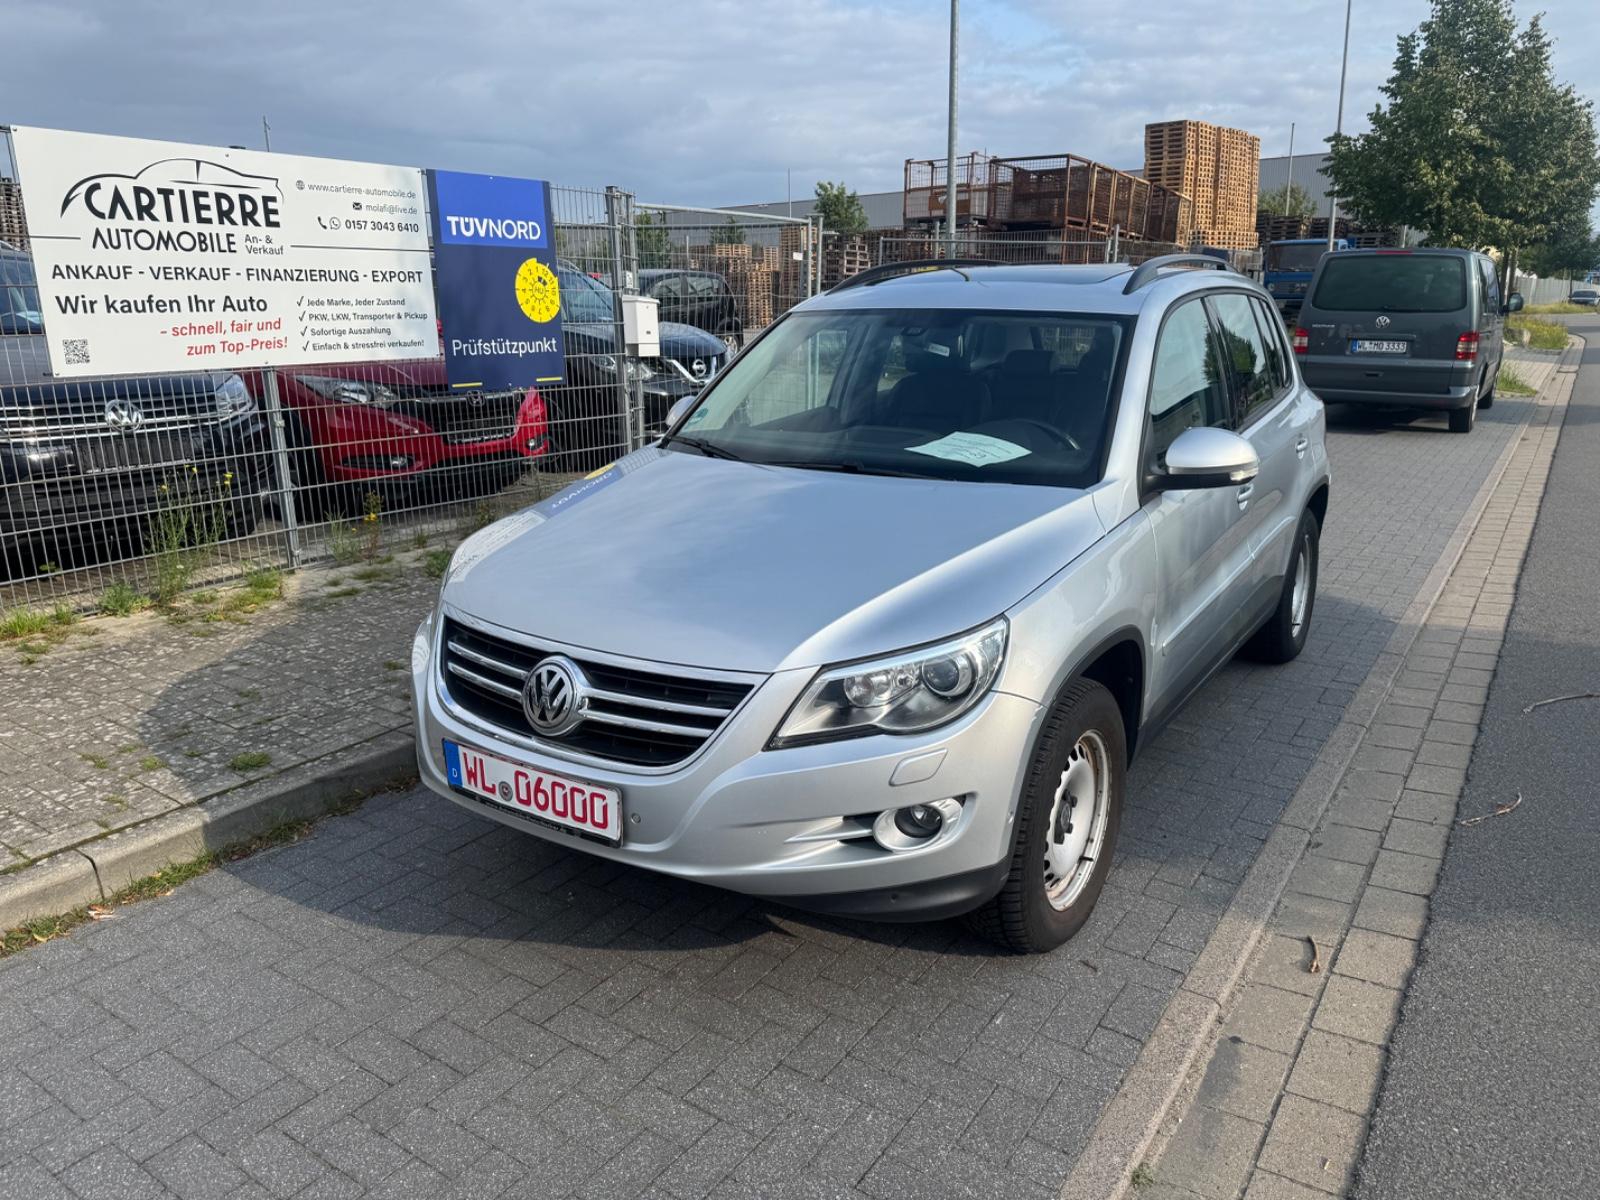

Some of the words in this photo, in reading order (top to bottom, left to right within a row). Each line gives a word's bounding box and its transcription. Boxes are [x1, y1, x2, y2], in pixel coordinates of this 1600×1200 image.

[308, 183, 416, 199] www.cartierre-automobile.de
[84, 182, 281, 228] CARTIERRE
[345, 219, 367, 230] 0157
[371, 220, 395, 231] 3043
[397, 222, 419, 233] 6410
[92, 227, 237, 253] AUTOMOBILE
[244, 234, 262, 244] An-
[265, 235, 273, 245] &
[245, 245, 284, 256] Verkauf
[51, 264, 133, 280] ANKAUF
[149, 266, 231, 281] VERKAUF
[246, 268, 359, 283] FINANZIERUNG
[371, 270, 423, 283] EXPORT
[55, 294, 98, 314] Wir
[104, 294, 181, 314] kaufen
[187, 294, 215, 313] Ihr
[222, 294, 268, 313] Auto
[307, 298, 325, 307] Jede
[327, 298, 353, 307] Marke,
[355, 298, 374, 306] Jeder
[376, 298, 406, 306] Zustand
[309, 313, 330, 321] PKW,
[332, 313, 351, 321] LKW,
[352, 312, 395, 321] Transporter
[404, 311, 428, 321] Pickup
[171, 320, 227, 337] schnell,
[230, 319, 253, 333] fair
[257, 318, 281, 331] und
[310, 328, 346, 337] Sofortige
[349, 326, 391, 336] Auszahlung
[187, 344, 215, 356] zum
[220, 336, 288, 355] Top-Preis!
[312, 342, 341, 351] Einfach
[344, 342, 349, 350] &
[351, 340, 386, 350] stressfrei
[387, 339, 424, 348] verkaufen!
[451, 337, 558, 357] Prüfstützpunkt
[451, 767, 458, 778] D
[463, 751, 496, 795] WL
[513, 769, 609, 830] 06000
